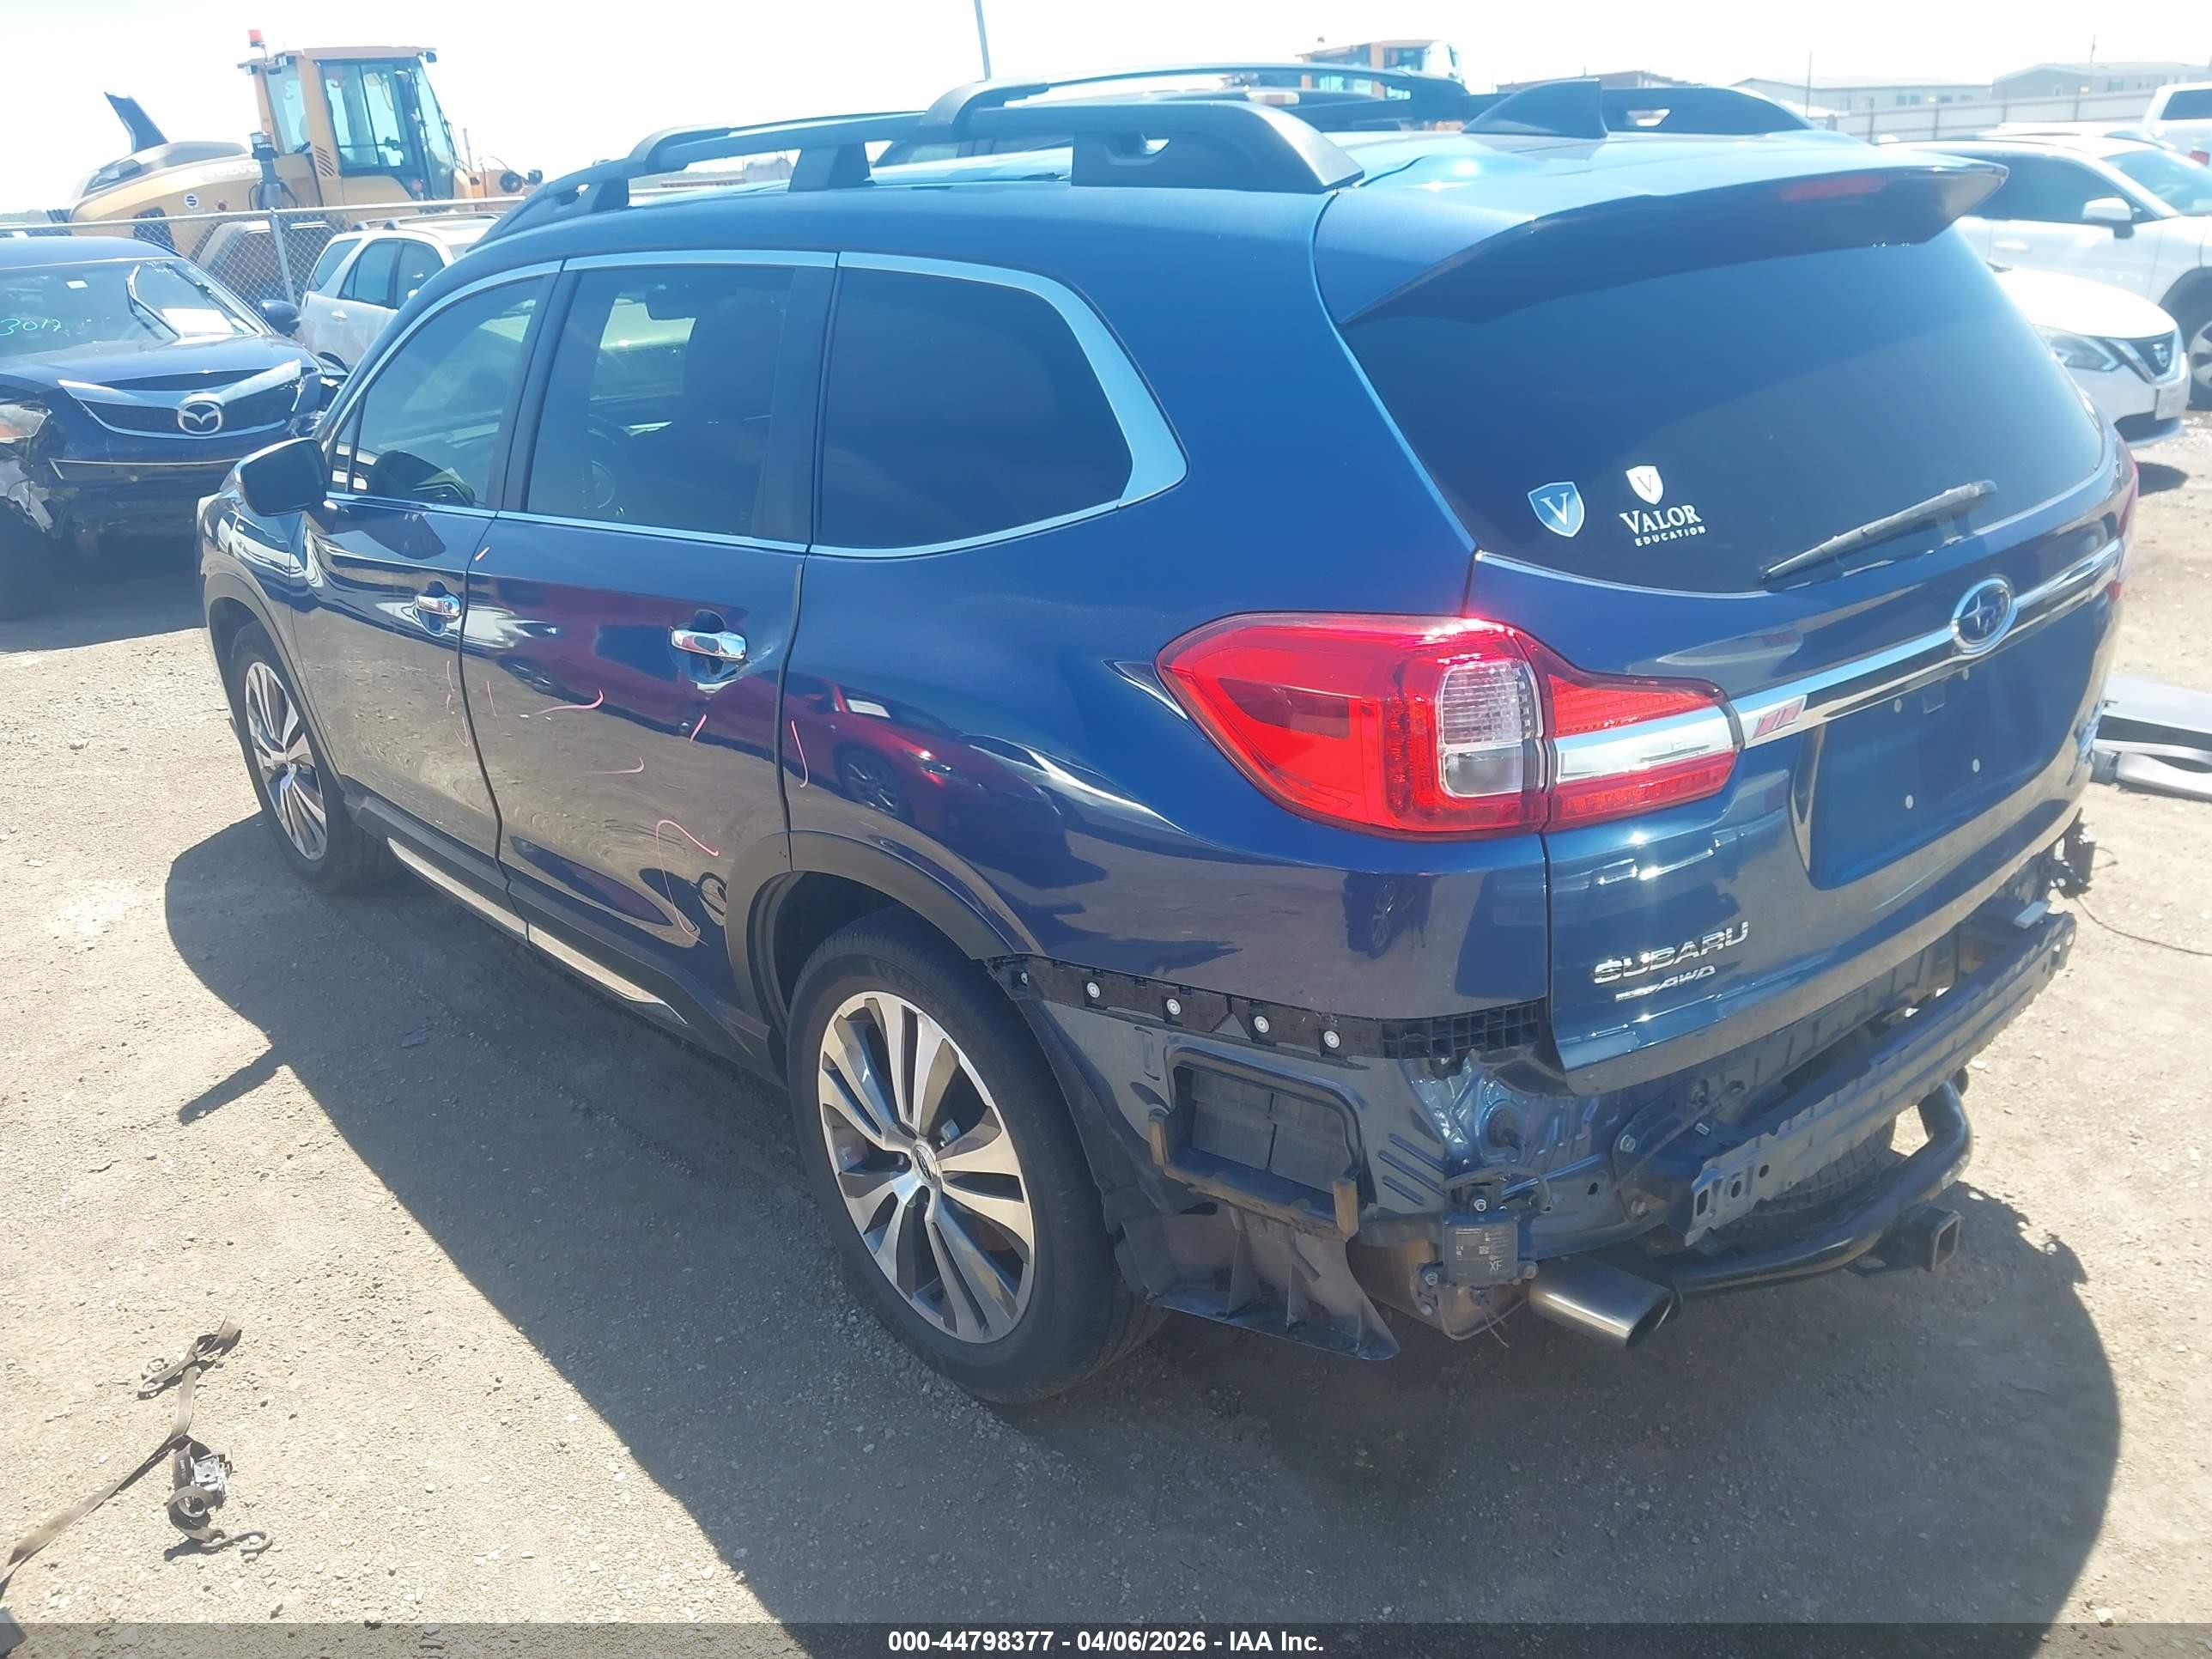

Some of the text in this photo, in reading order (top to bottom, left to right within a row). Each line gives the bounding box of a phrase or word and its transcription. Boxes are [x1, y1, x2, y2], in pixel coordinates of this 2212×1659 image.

[1638, 474, 1651, 494] V
[1540, 492, 1569, 526] V
[1620, 504, 1702, 534] VALOR
[1635, 526, 1705, 547] EDUCATION
[1594, 921, 1749, 984] SUBARU
[1656, 964, 1716, 993] AWD
[1489, 1260, 1503, 1272] XF
